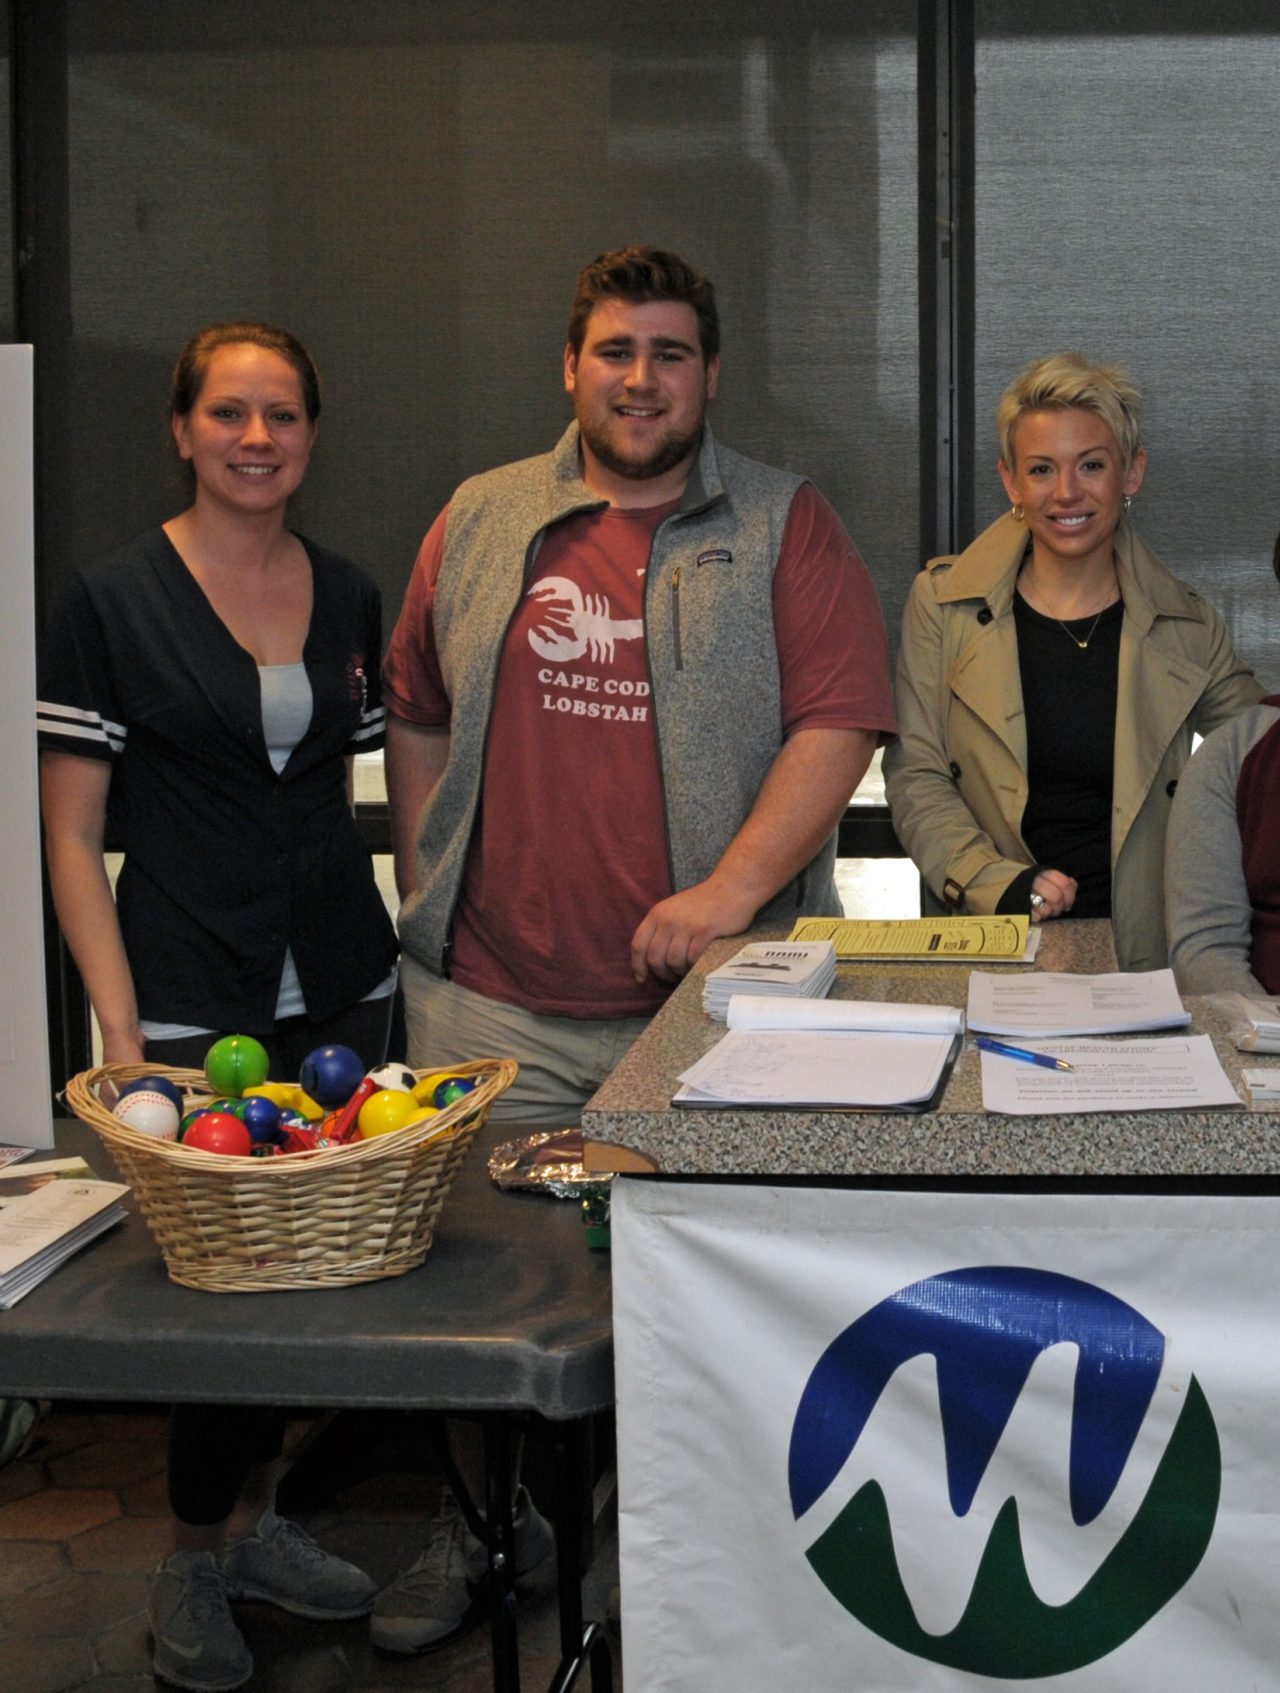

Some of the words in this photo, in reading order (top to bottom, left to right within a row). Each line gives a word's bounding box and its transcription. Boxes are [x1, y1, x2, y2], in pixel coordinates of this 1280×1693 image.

[538, 668, 599, 692] CAPE
[604, 679, 650, 697] COD
[542, 694, 648, 722] LOBSTAH
